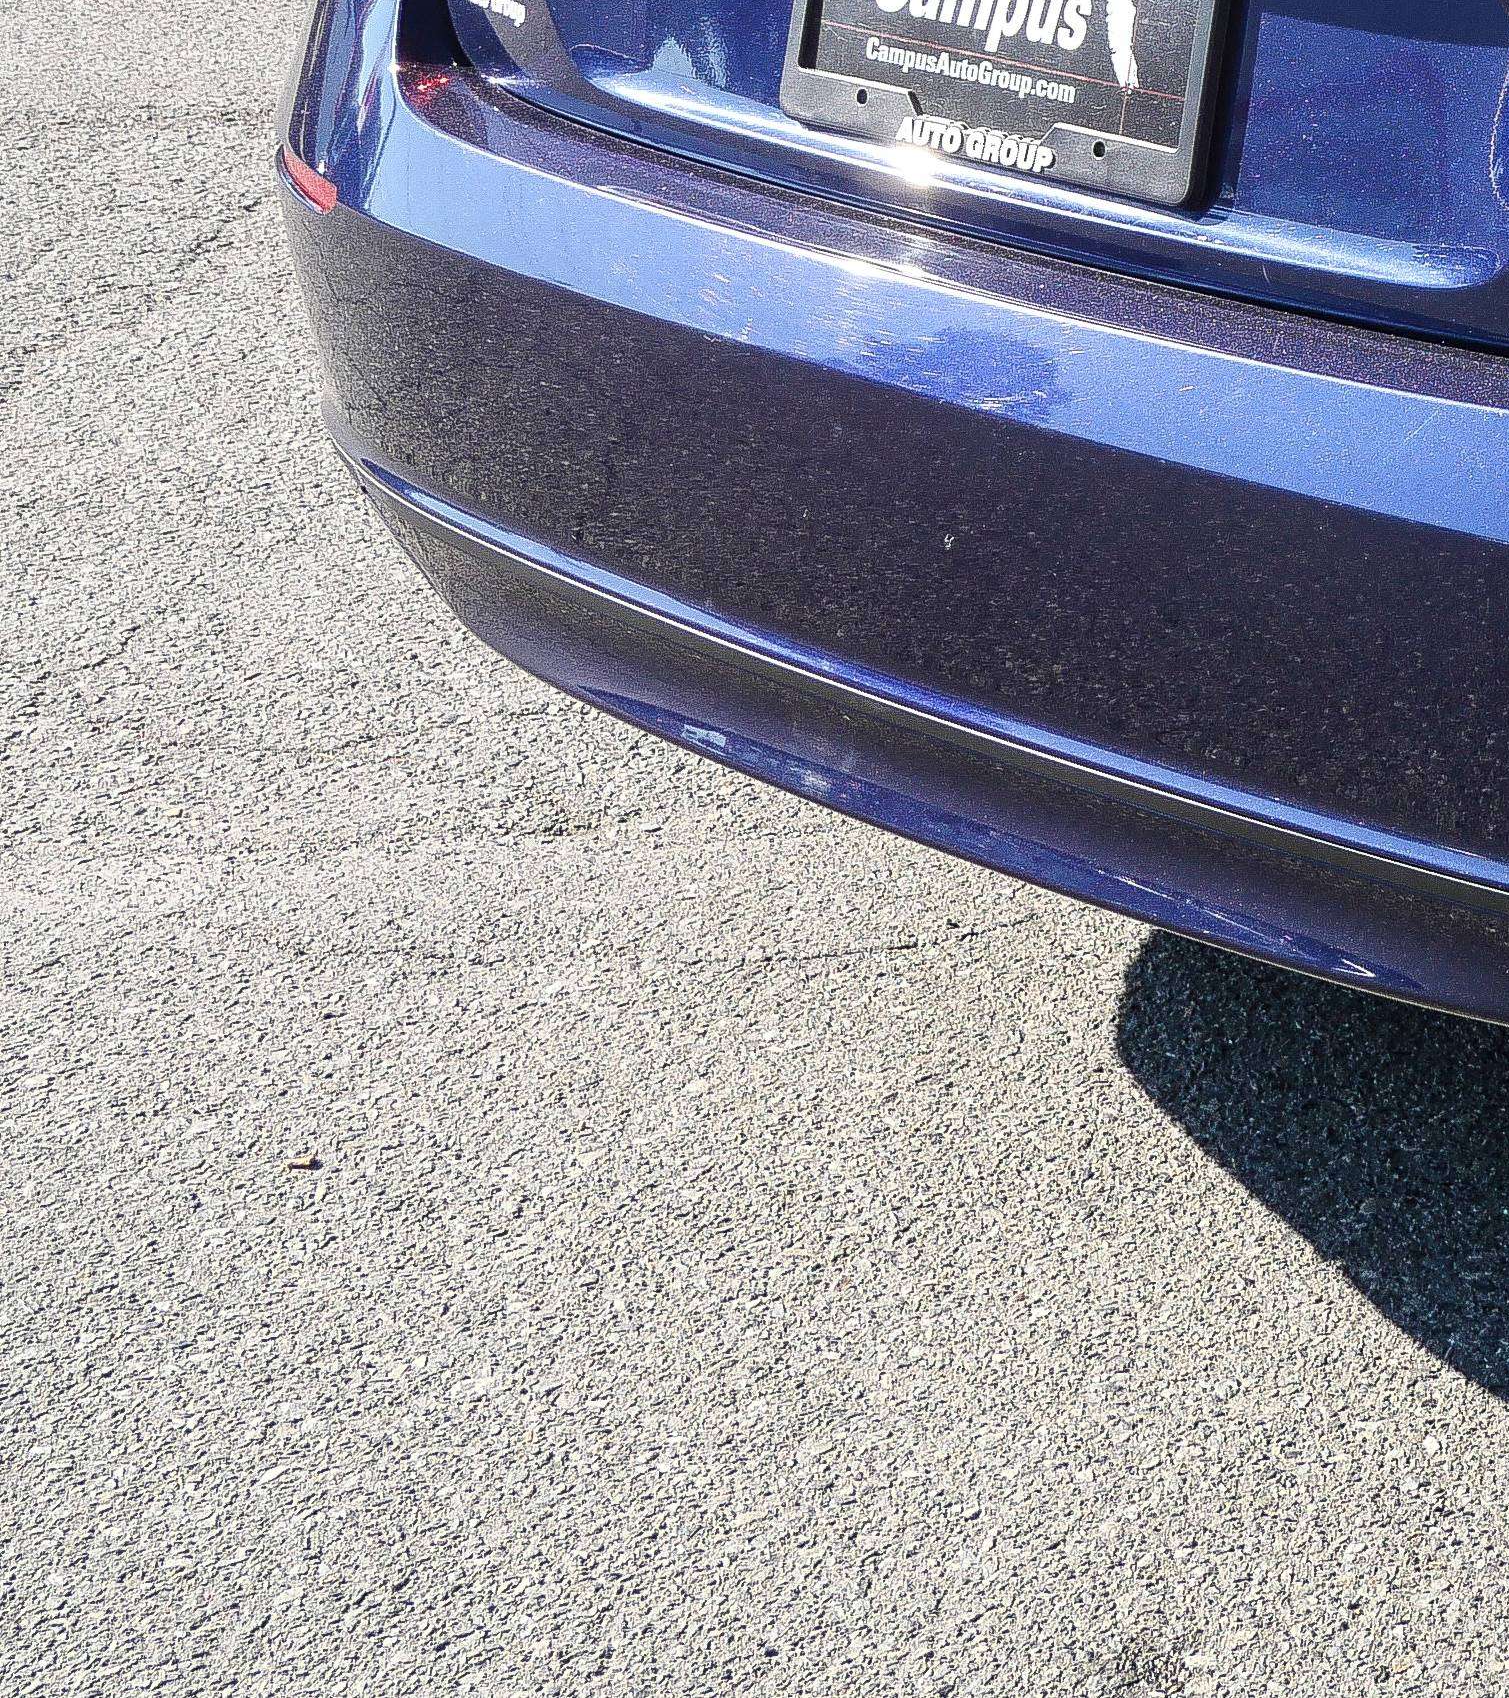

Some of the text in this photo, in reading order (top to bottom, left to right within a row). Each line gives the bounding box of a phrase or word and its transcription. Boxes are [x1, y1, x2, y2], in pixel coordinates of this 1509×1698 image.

[865, 36, 1076, 103] CampusAutoGroup.com
[896, 116, 1055, 173] AUTO GROUP
